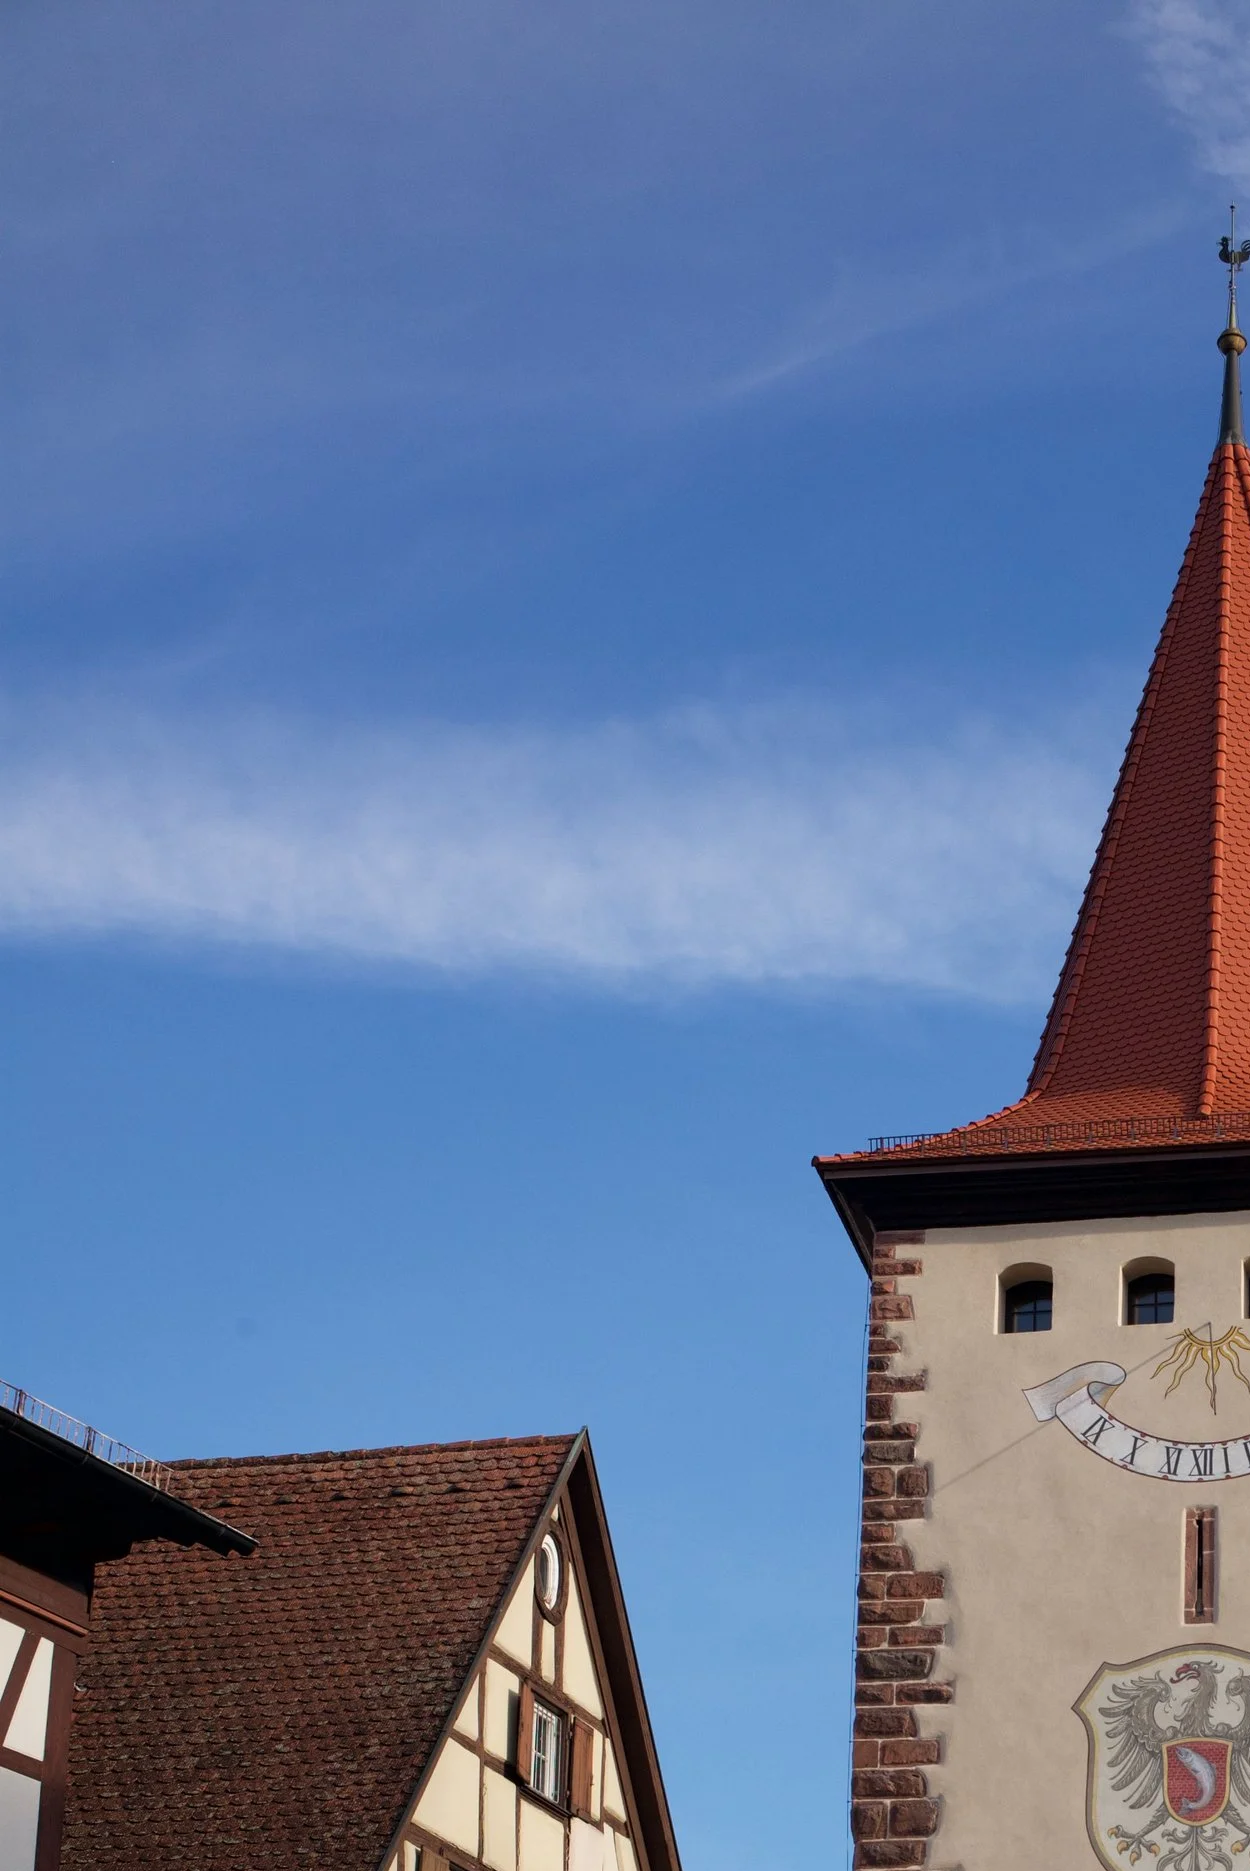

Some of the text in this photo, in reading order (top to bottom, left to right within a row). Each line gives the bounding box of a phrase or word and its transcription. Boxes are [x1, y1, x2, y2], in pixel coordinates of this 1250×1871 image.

[1081, 1415, 1115, 1446] IX
[1120, 1436, 1148, 1465] X
[1158, 1446, 1182, 1476] XI
[1188, 1448, 1214, 1476] XII
[1222, 1447, 1232, 1473] I
